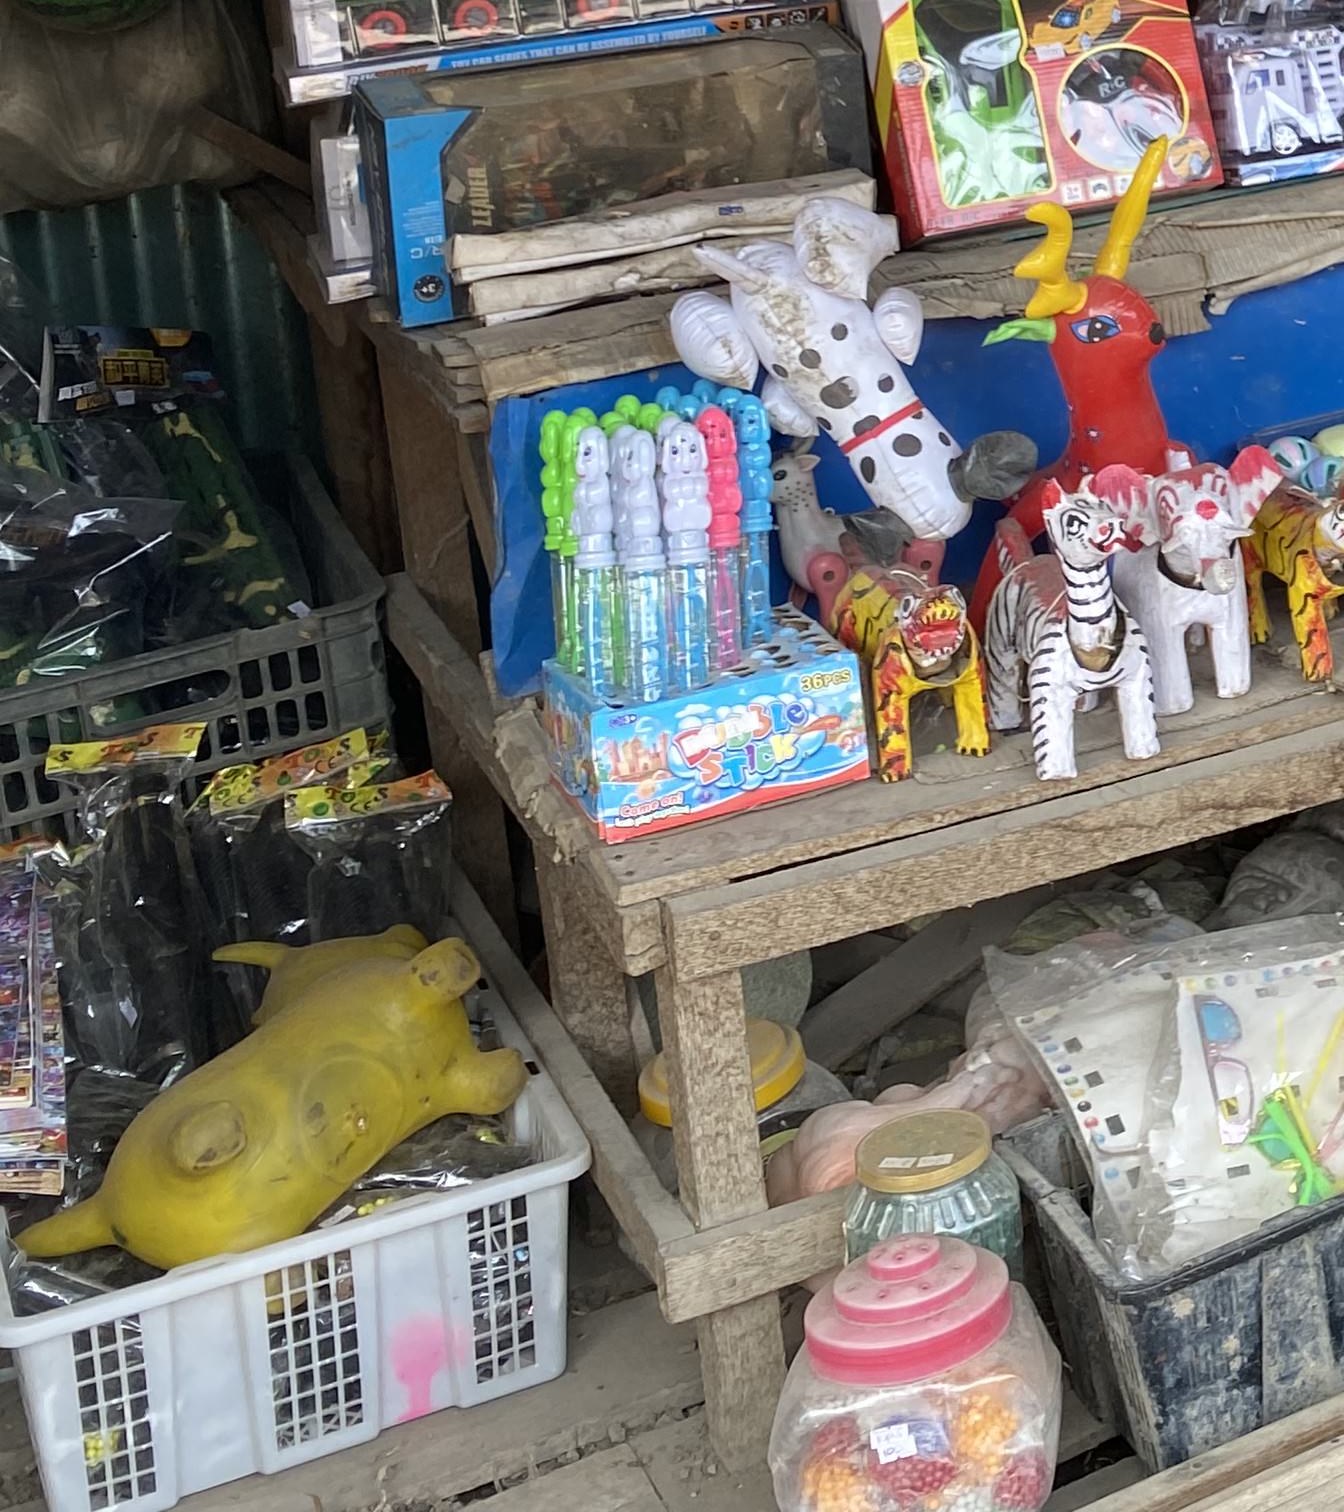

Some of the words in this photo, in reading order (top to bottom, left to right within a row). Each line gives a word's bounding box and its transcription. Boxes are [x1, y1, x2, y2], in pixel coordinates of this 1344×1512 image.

[528, 47, 552, 61] THAT
[552, 44, 574, 58] CAN
[799, 669, 854, 694] 36PCS
